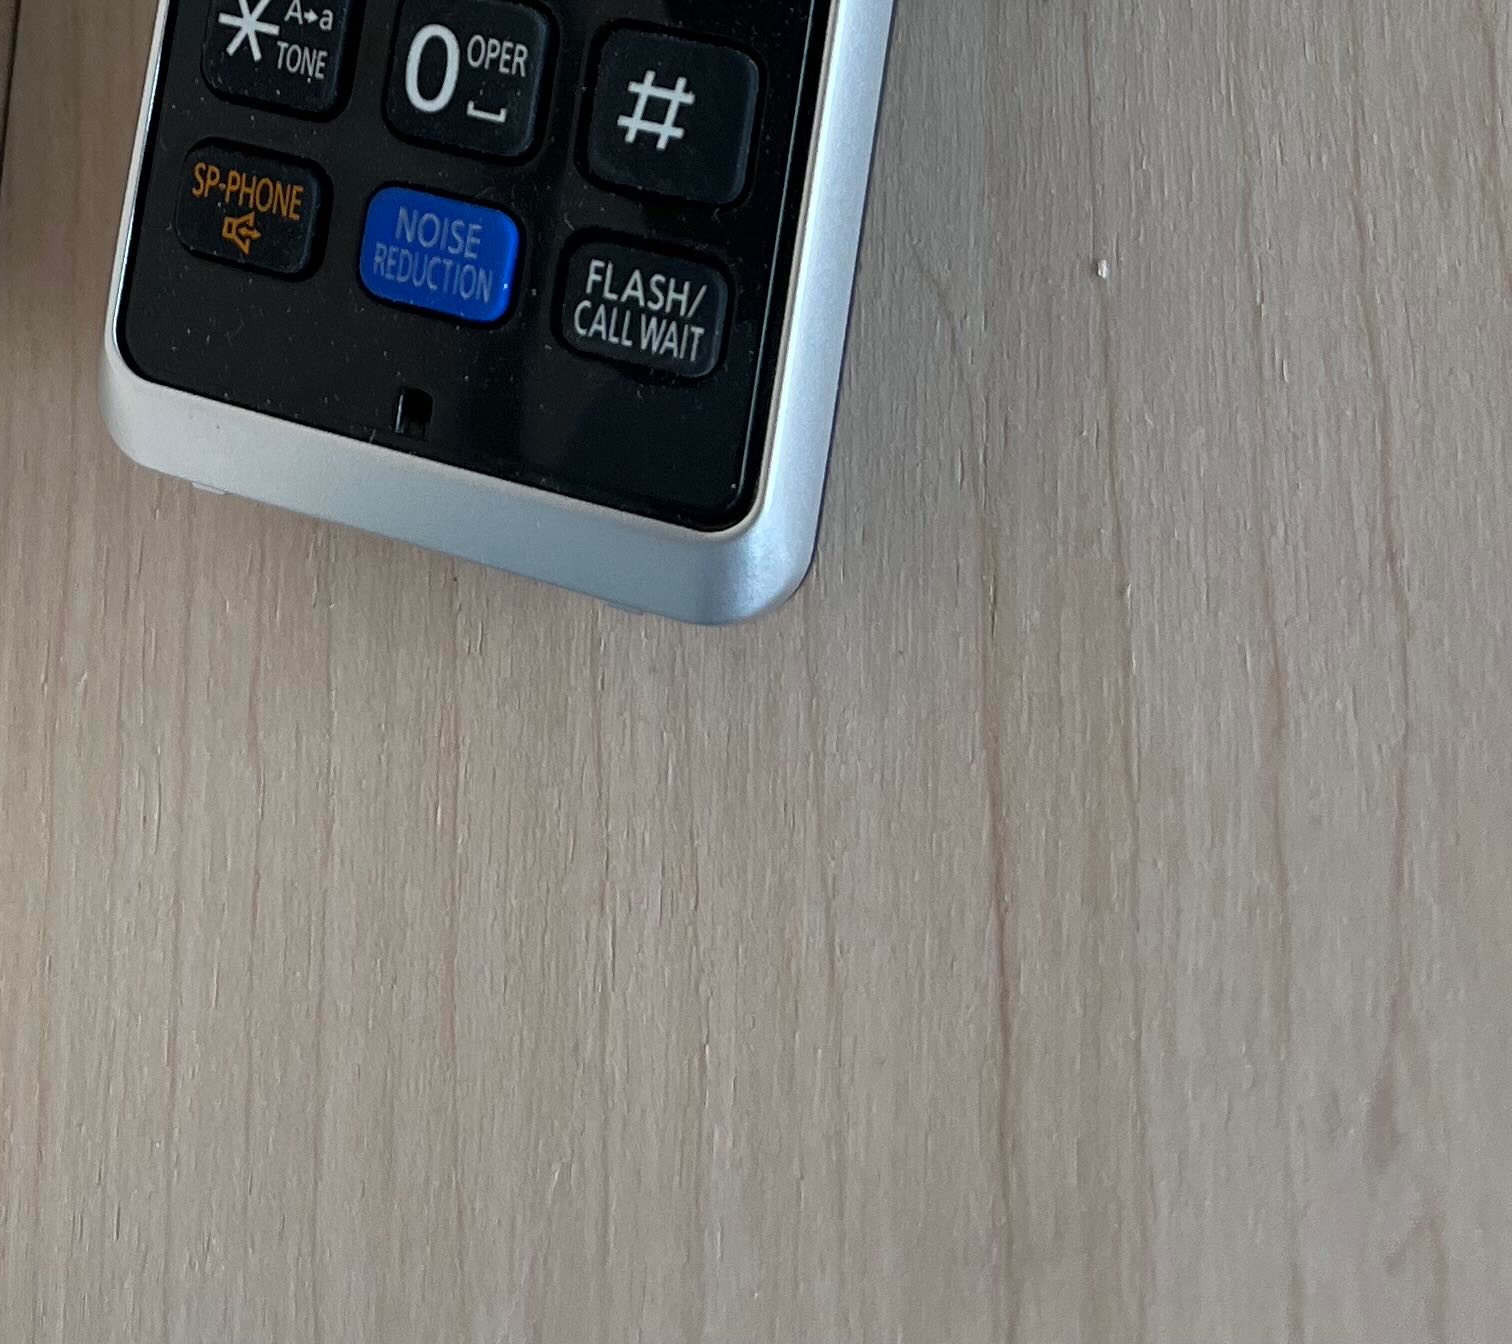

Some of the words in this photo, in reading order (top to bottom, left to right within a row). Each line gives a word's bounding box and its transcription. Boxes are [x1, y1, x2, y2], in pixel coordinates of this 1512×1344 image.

[276, 42, 328, 82] TONE
[404, 23, 459, 112] 0
[467, 35, 529, 78] OPER
[191, 161, 305, 221] SP-PHONE
[395, 207, 481, 257] NOISE
[372, 242, 492, 304] REDUCTION
[584, 258, 707, 320] FLASH/
[573, 300, 639, 348] CALL
[640, 318, 705, 364] WAIT
